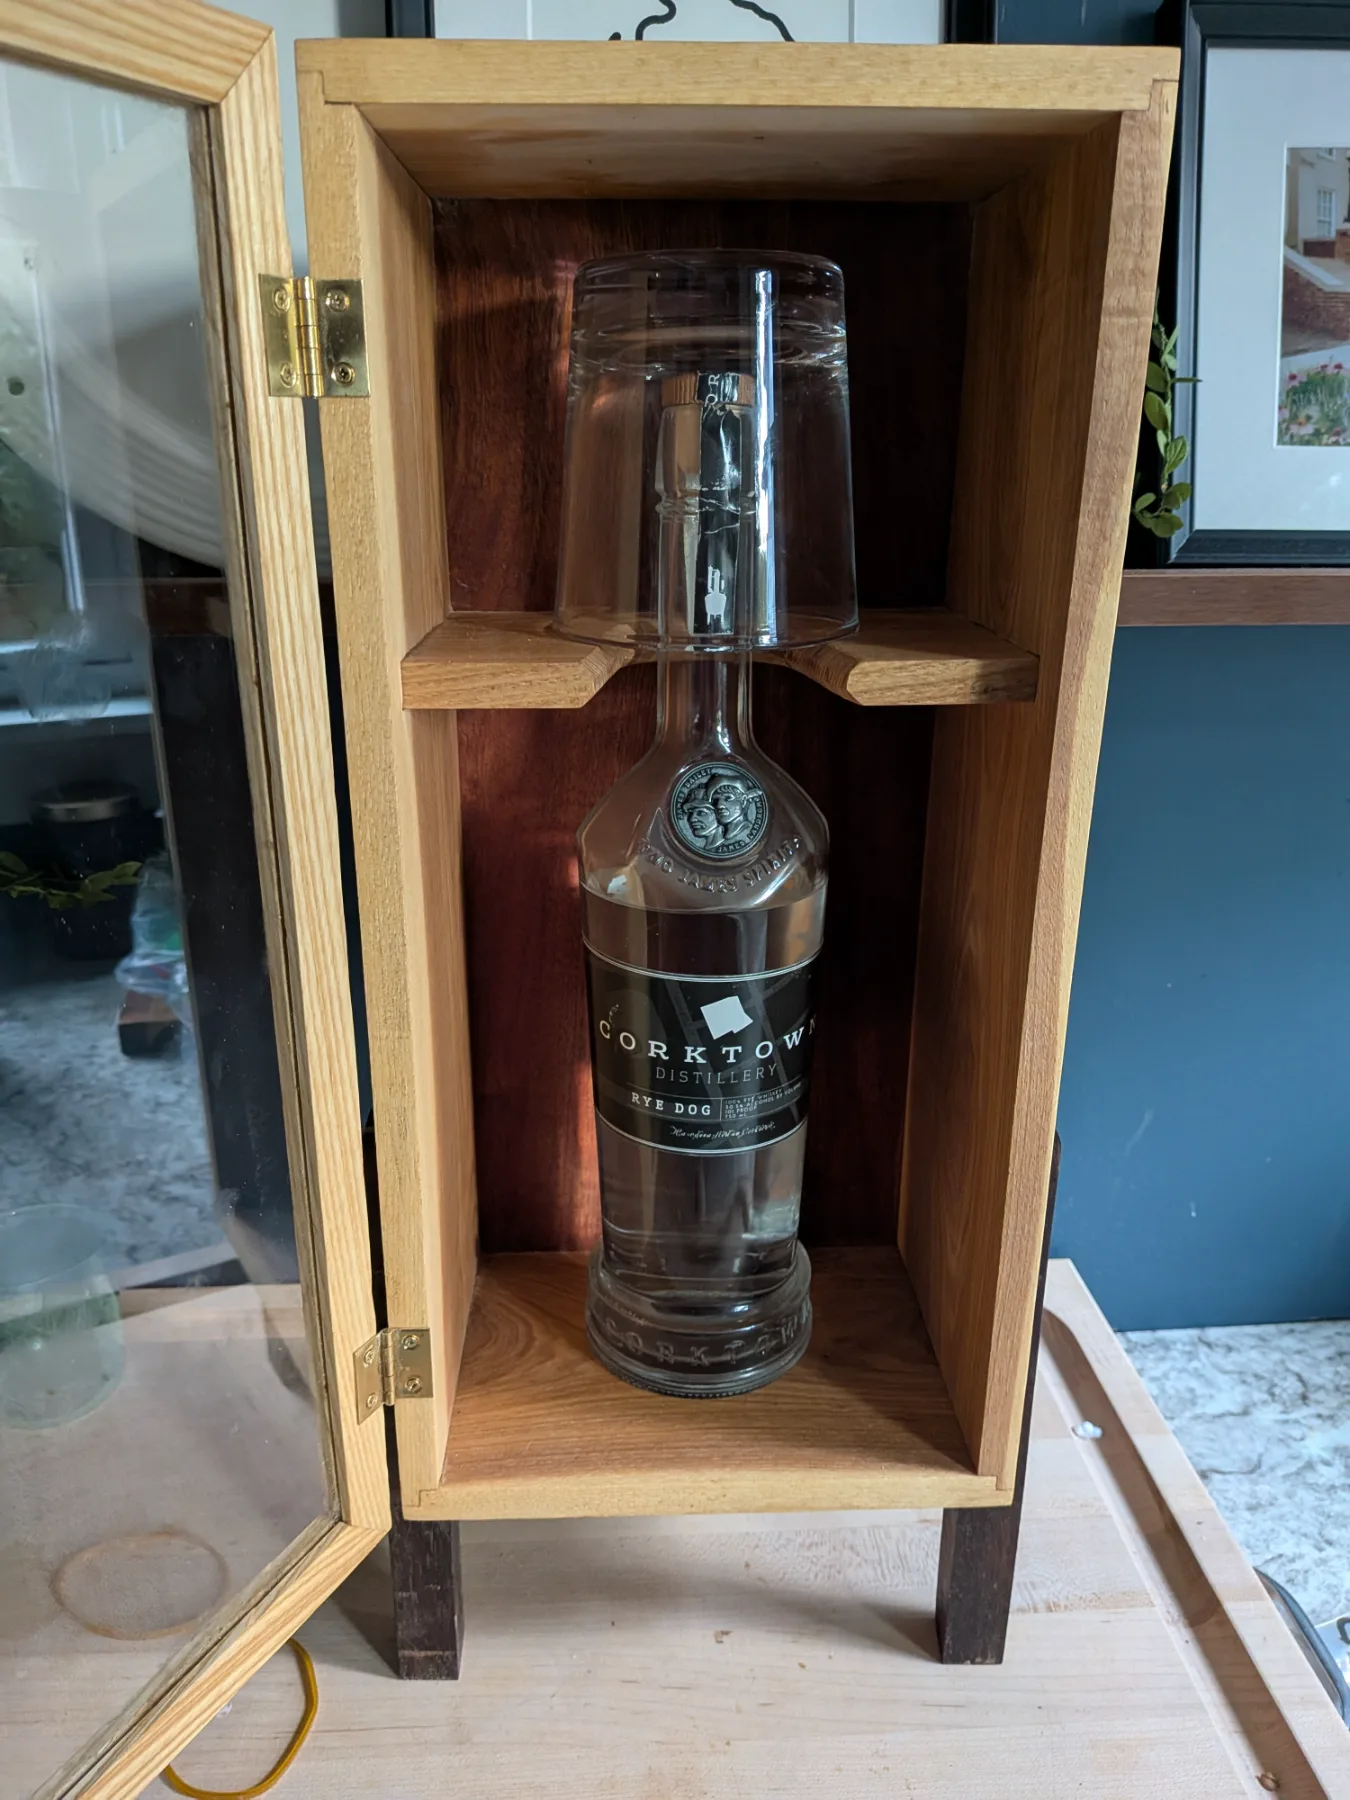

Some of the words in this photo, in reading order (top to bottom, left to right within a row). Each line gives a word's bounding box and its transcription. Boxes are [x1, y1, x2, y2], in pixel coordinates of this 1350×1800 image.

[717, 841, 747, 853] JAMES
[655, 1063, 778, 1084] DISTILLERY
[631, 1092, 664, 1111] RYE
[674, 1102, 711, 1116] DOG
